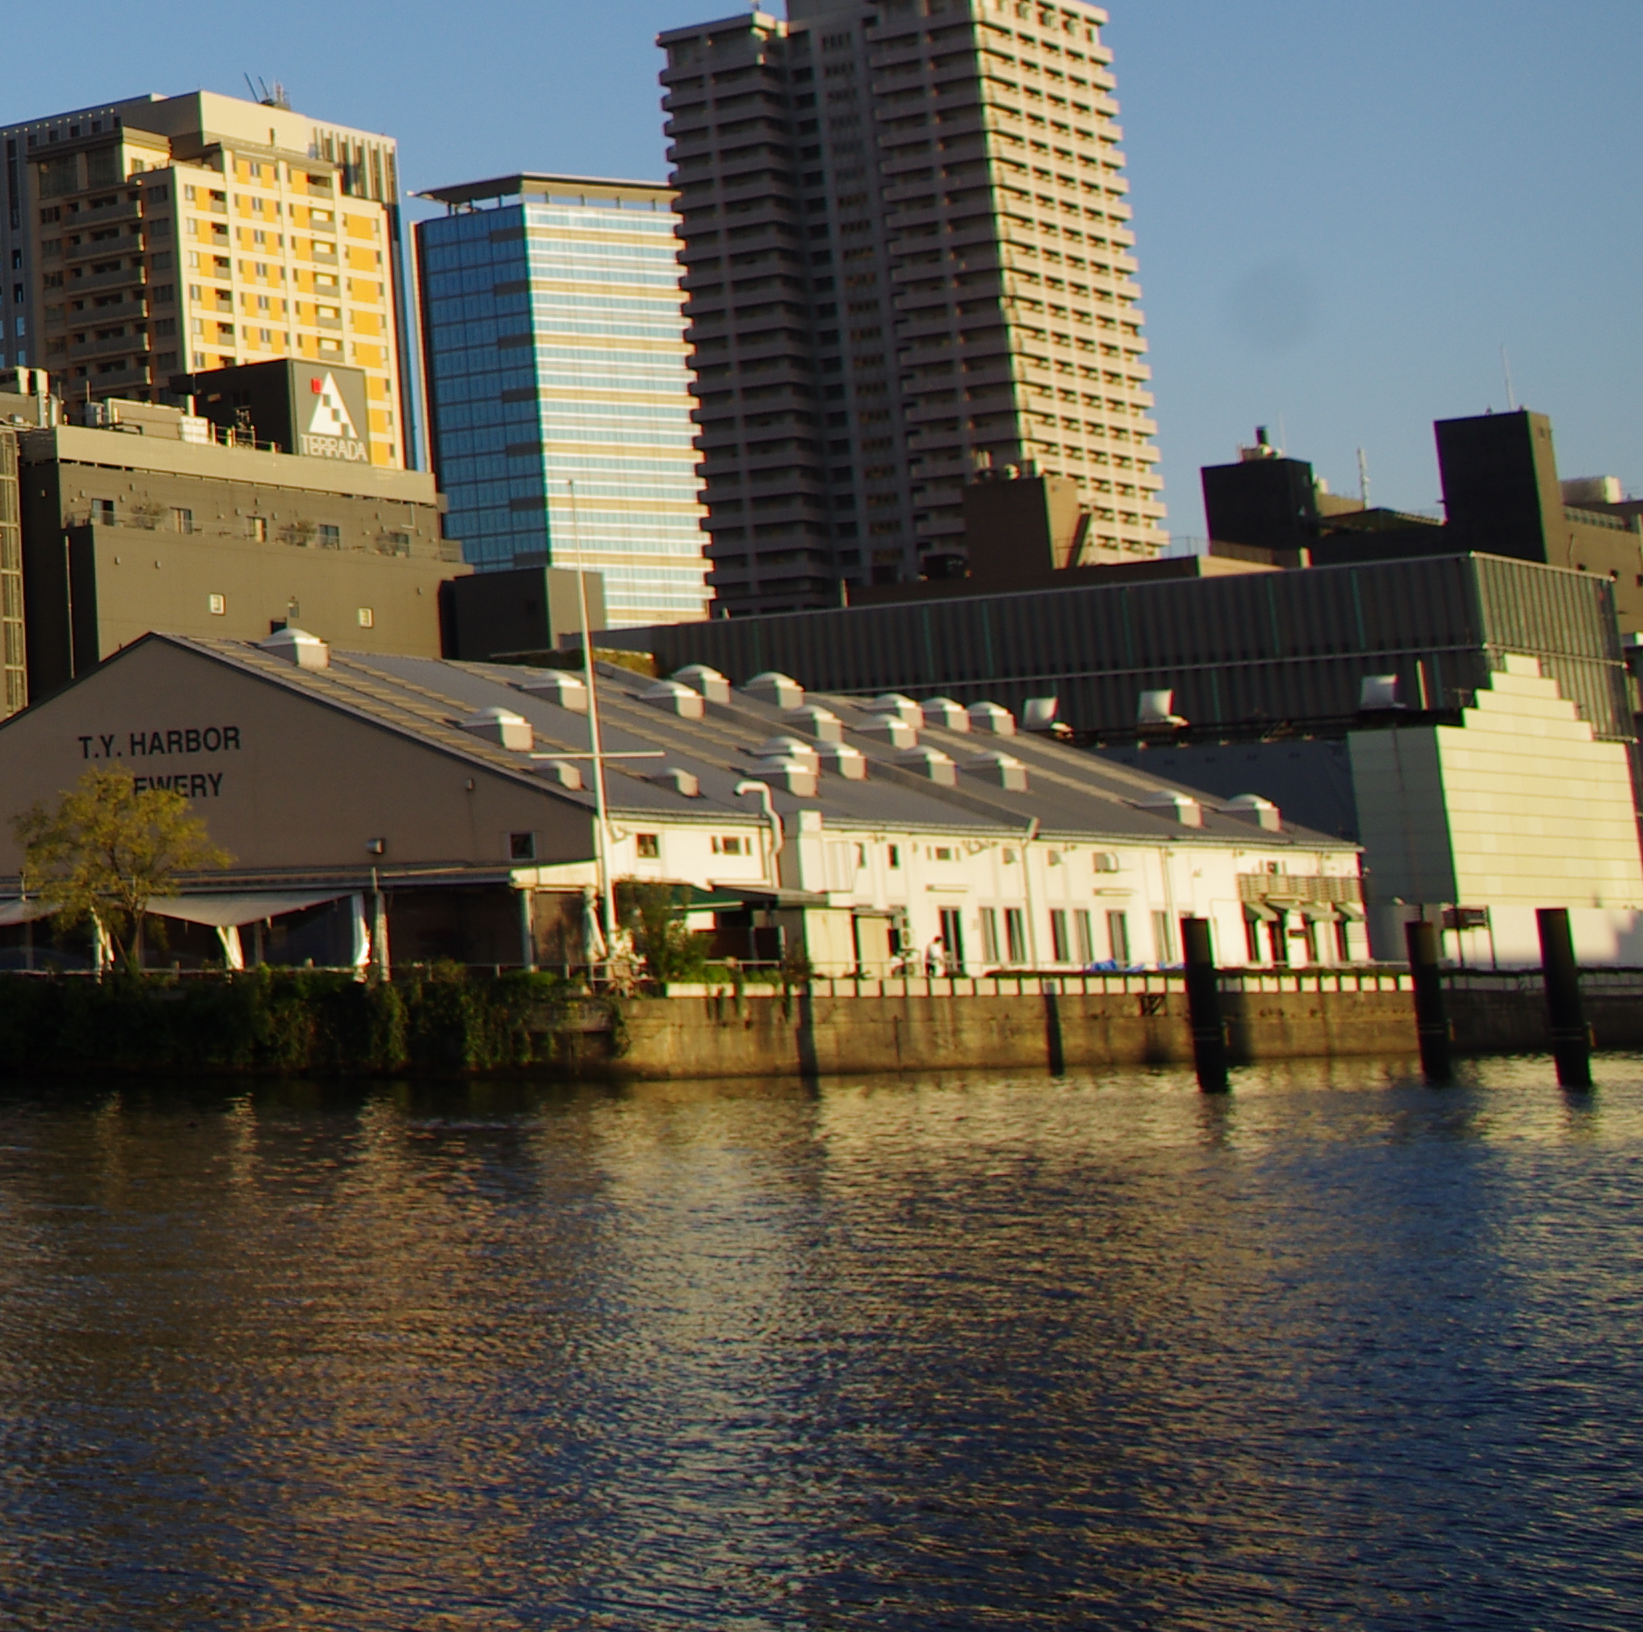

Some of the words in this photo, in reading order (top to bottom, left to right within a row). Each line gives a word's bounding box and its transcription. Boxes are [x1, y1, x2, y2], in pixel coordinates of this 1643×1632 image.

[301, 434, 369, 462] TERRADA
[78, 734, 123, 759] T.Y.
[130, 726, 241, 757] HARBOR
[133, 773, 224, 799] EWERY
